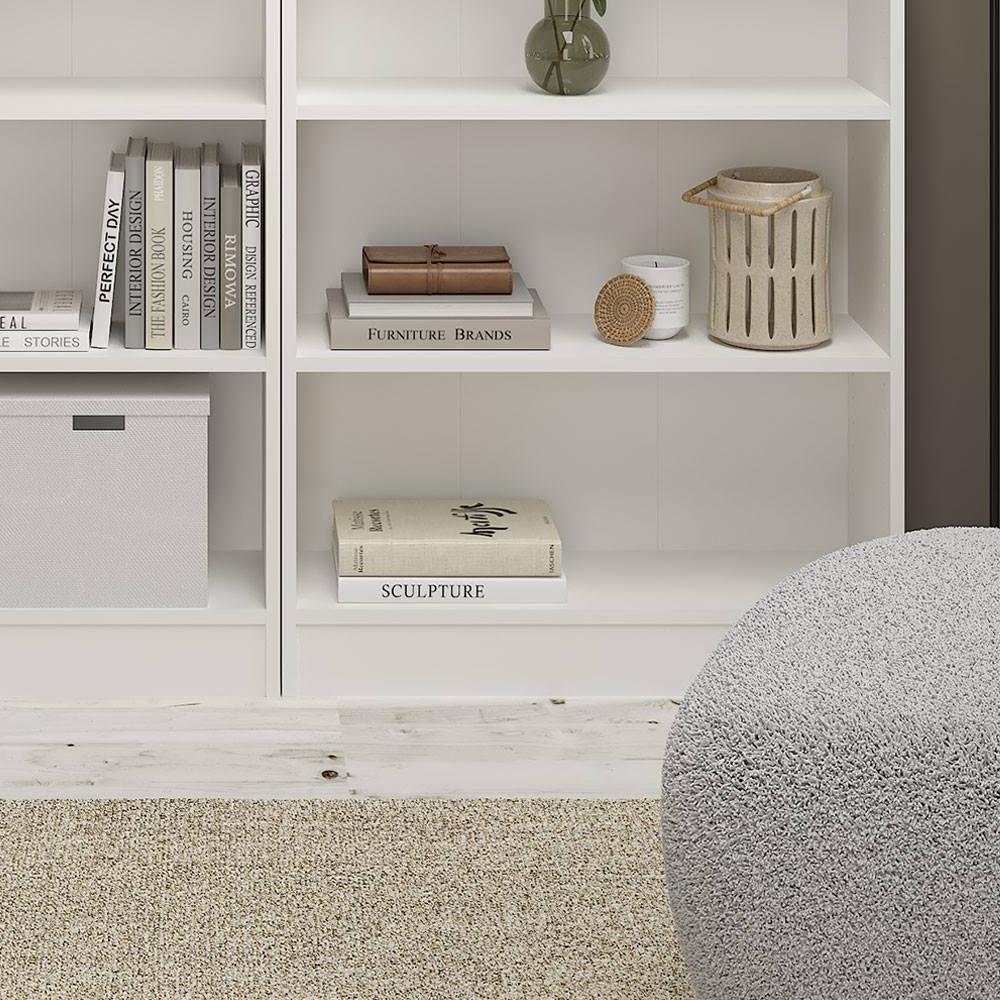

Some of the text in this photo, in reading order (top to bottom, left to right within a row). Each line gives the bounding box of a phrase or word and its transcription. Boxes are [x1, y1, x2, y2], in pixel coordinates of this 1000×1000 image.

[99, 198, 120, 303] PERFECT DAY
[128, 190, 143, 317] INTERIOR DESIGN
[150, 227, 166, 339] THE FASHION BOOK
[181, 210, 193, 280] HOUSING
[202, 196, 217, 319] INTERIOR DESIGN
[224, 233, 237, 310] RIMOWA
[244, 169, 261, 349] GRAPHIC DISIGN REFERENCED
[23, 336, 80, 349] STORIES
[181, 294, 190, 327] CAIRO
[368, 327, 512, 341] FURNITURE BRANDS
[381, 583, 485, 599] SCULPTURE
